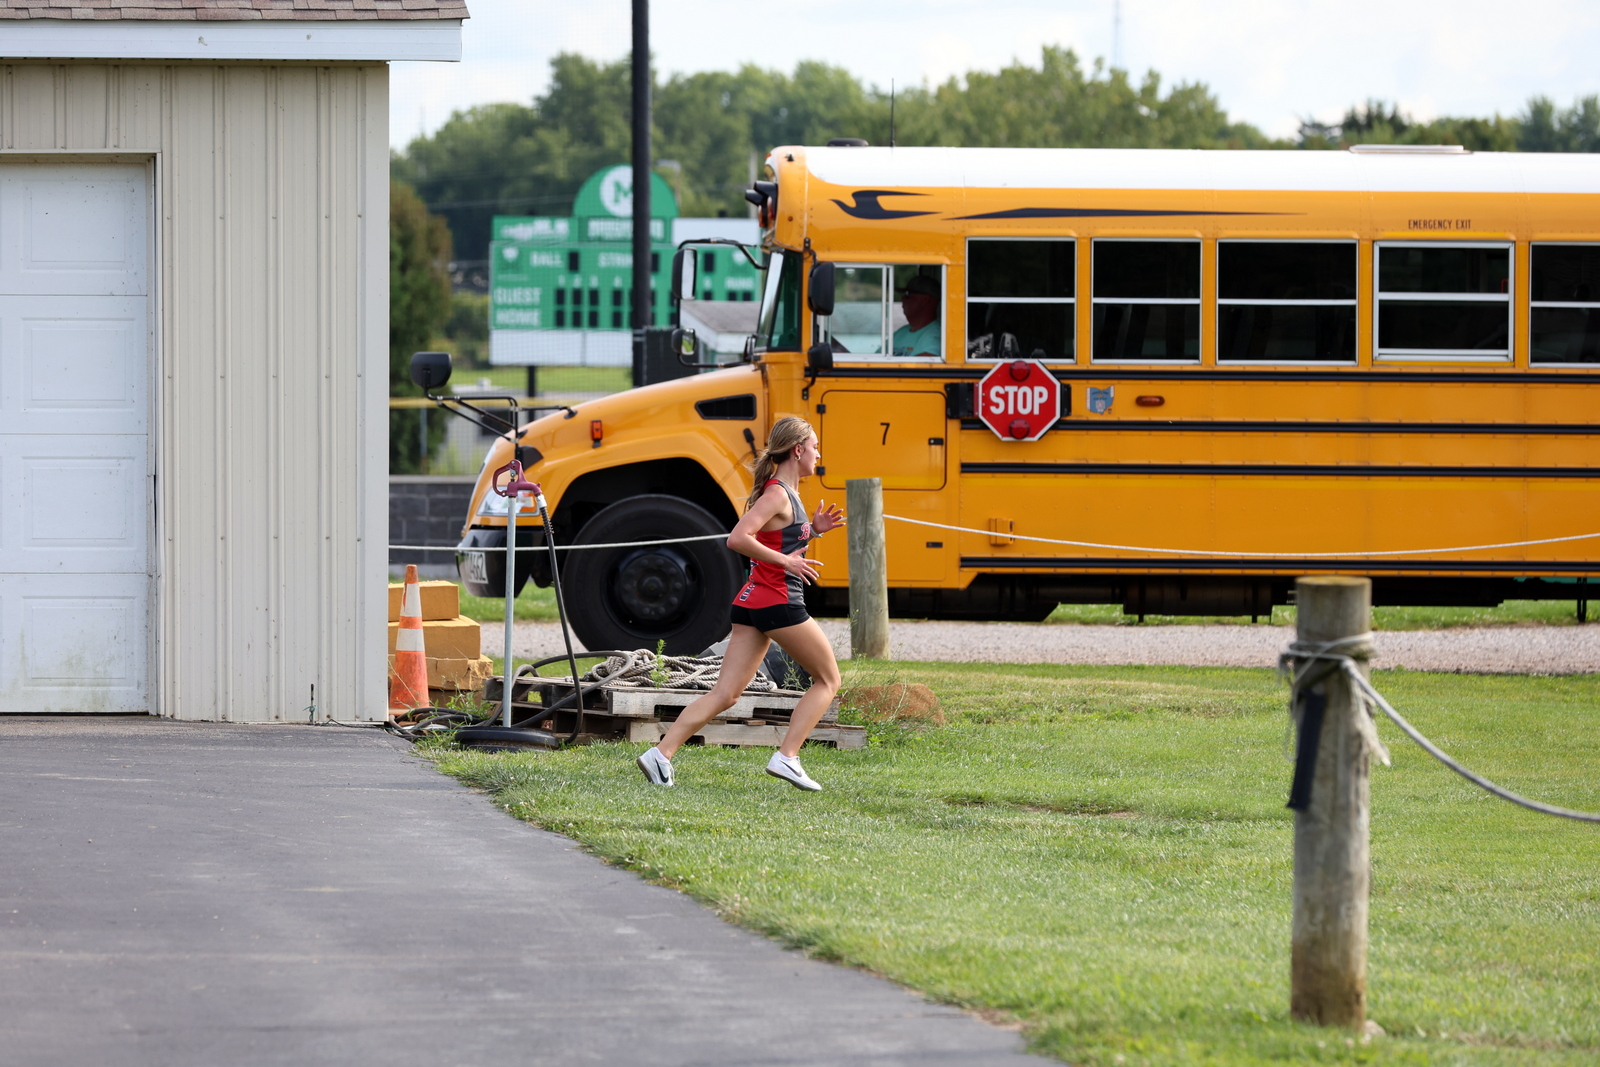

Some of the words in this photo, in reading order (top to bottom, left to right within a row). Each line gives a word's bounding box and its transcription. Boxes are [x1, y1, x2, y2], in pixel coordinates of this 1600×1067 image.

[1408, 219, 1452, 230] EMERGENCY
[1455, 219, 1472, 230] EXIT
[530, 250, 564, 268] BALL
[493, 286, 542, 305] GUEST
[495, 308, 541, 326] HOME
[989, 385, 1049, 415] STOP
[880, 422, 890, 446] 7
